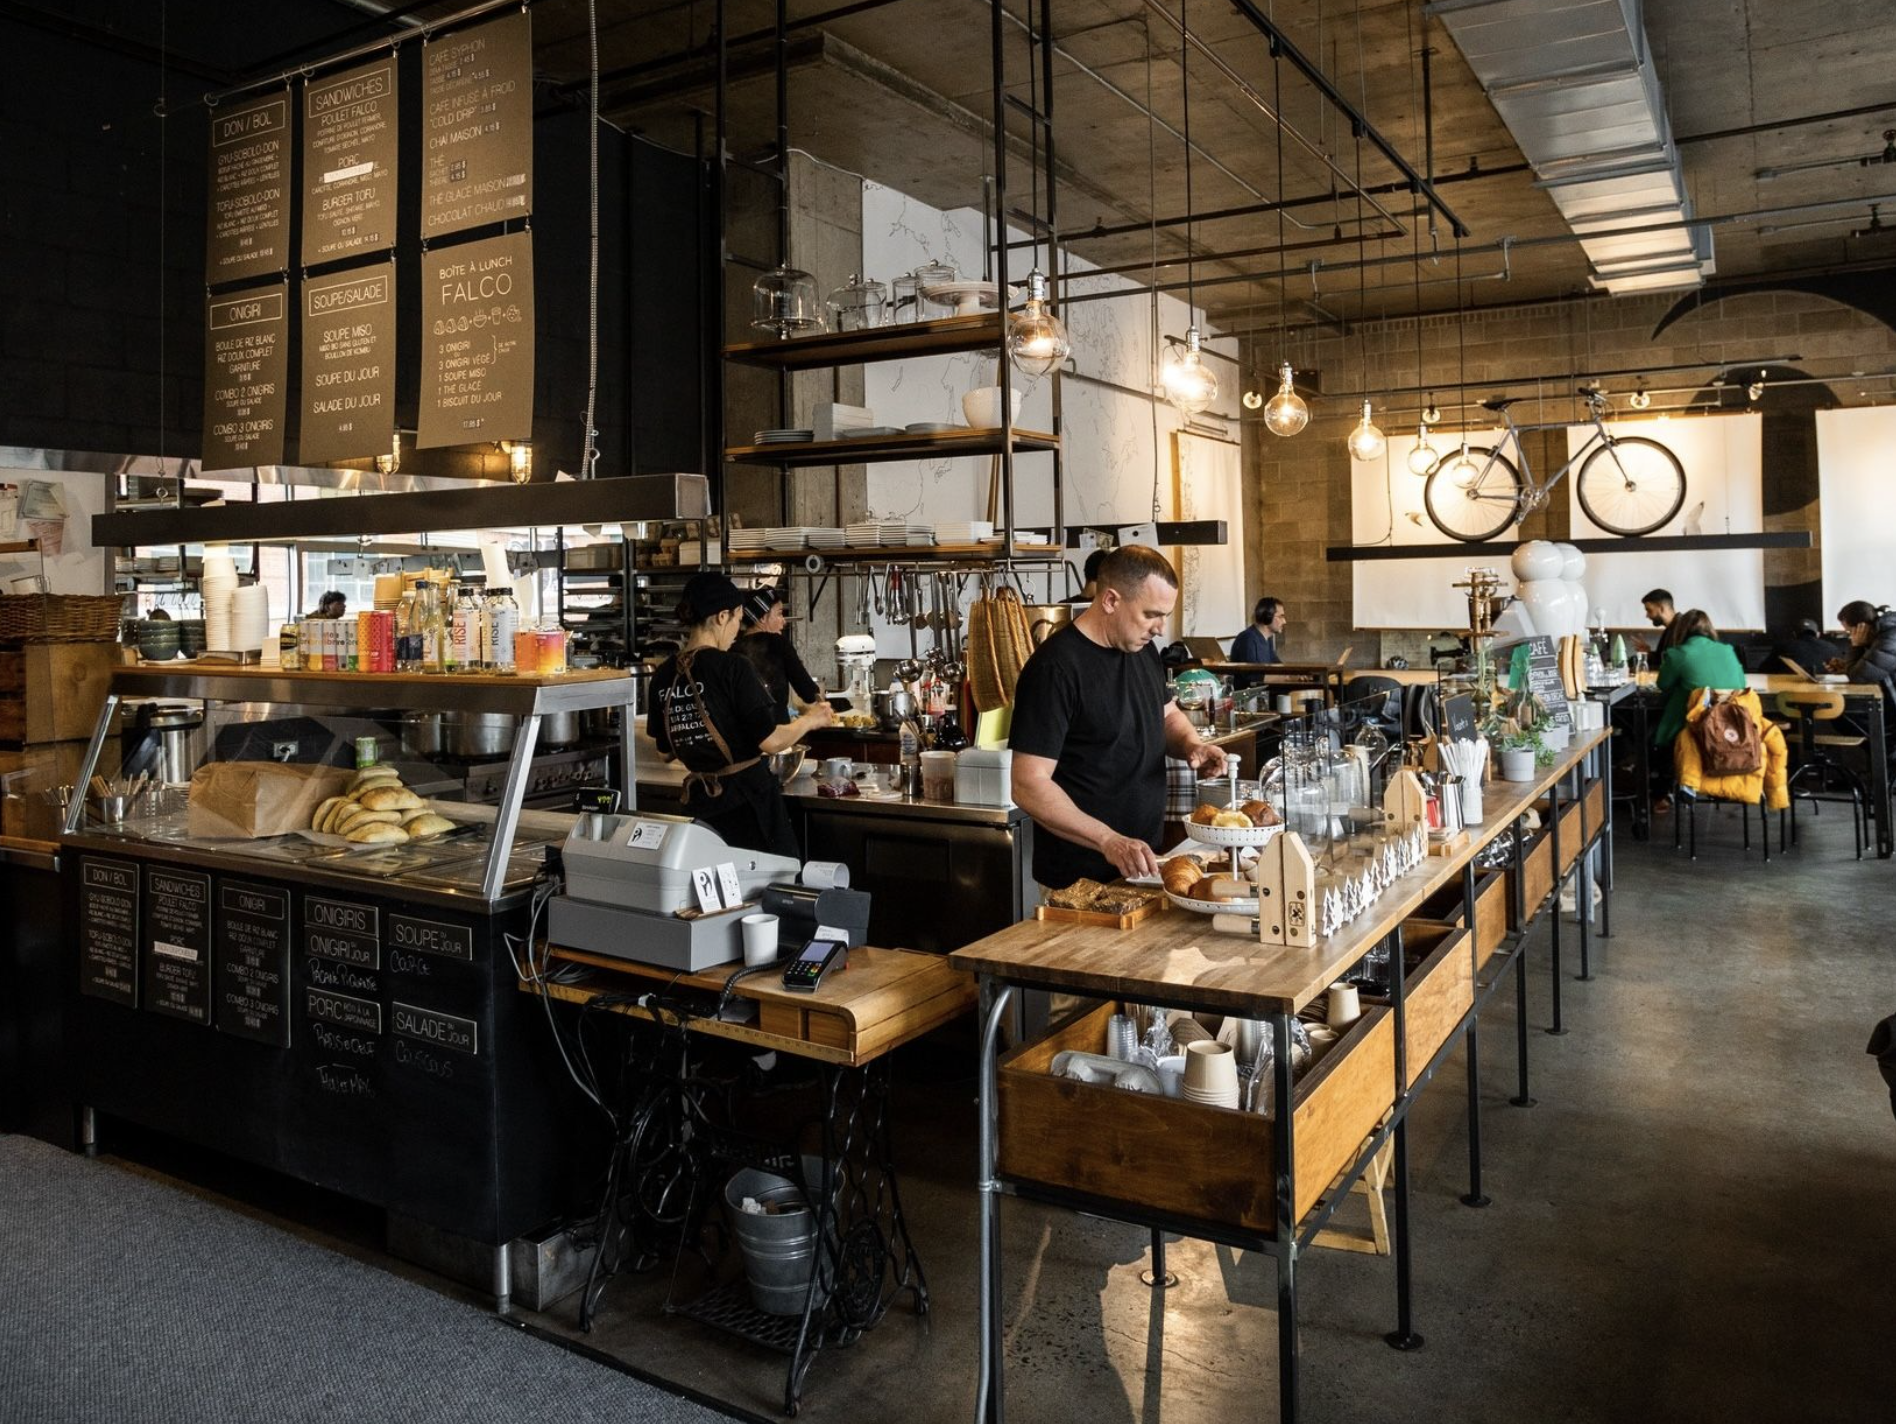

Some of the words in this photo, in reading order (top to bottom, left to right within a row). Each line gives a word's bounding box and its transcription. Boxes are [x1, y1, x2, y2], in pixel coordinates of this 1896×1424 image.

[452, 39, 485, 58] SYPHON
[316, 77, 382, 110] SANDWICHES
[491, 80, 515, 96] FROID
[321, 109, 348, 126] POULET
[352, 101, 377, 116] FALCO
[224, 120, 243, 137] DON
[253, 112, 271, 128] BOL
[450, 126, 481, 142] MAISON
[338, 154, 359, 167] PORC
[474, 179, 505, 194] MAISON
[217, 189, 280, 211] TOFU-SOBOLO-DON
[323, 194, 352, 211] BURGER
[356, 188, 375, 201] TOFU
[428, 206, 472, 226] CHOCOLAT
[475, 199, 504, 215] CHAUD
[439, 265, 465, 279] BOÎTE
[470, 261, 476, 272] À
[479, 256, 512, 271] LUNCH
[314, 284, 381, 309] SOUPE/SALADE
[442, 274, 512, 304] FALCO
[230, 303, 261, 321] ONIGIRI
[216, 340, 234, 351] BOULE
[236, 338, 243, 348] DE
[245, 337, 254, 346] RIZ
[256, 333, 275, 345] BLANC
[324, 327, 349, 343] SOUPE
[352, 324, 372, 337] MISO
[218, 353, 226, 362] RIZ
[228, 351, 244, 362] DOUX
[246, 346, 273, 358] COMPLET
[439, 345, 444, 354] 3
[446, 341, 470, 352] ONIGIRI
[230, 360, 260, 373] GARNITURE
[439, 361, 443, 370] 3
[446, 357, 469, 368] ONIGIRI
[473, 353, 490, 364] VÉGÉ
[316, 372, 341, 386] SOUPE
[344, 371, 355, 382] DU
[358, 366, 379, 381] JOUR
[444, 370, 466, 382] SOUPE
[469, 368, 486, 377] MISO
[215, 388, 239, 400] COMBO
[241, 387, 246, 398] 2
[443, 396, 468, 407] BISCUIT
[471, 394, 481, 404] DU
[483, 391, 502, 402] JOUR
[314, 399, 342, 413] SALADE
[345, 397, 357, 409] DU
[359, 393, 380, 407] JOUR
[214, 423, 237, 435] COMBO
[239, 423, 244, 433] 3
[455, 621, 467, 645] RISE
[491, 621, 500, 645] RISE
[93, 869, 108, 881] DON
[155, 878, 200, 897] SANDWICHES
[239, 895, 265, 910] ONIGIRI
[314, 905, 365, 929] ONIGIRIS
[396, 924, 438, 949] SOUPE
[311, 935, 350, 957] ONIGIRI
[351, 946, 370, 962] JOUR
[441, 941, 461, 953] JOUR
[227, 963, 248, 975] COMBO
[226, 993, 248, 1006] COMBO
[309, 995, 342, 1019] PORC
[397, 1012, 445, 1040] SALADE
[448, 1032, 469, 1045] JOUR
